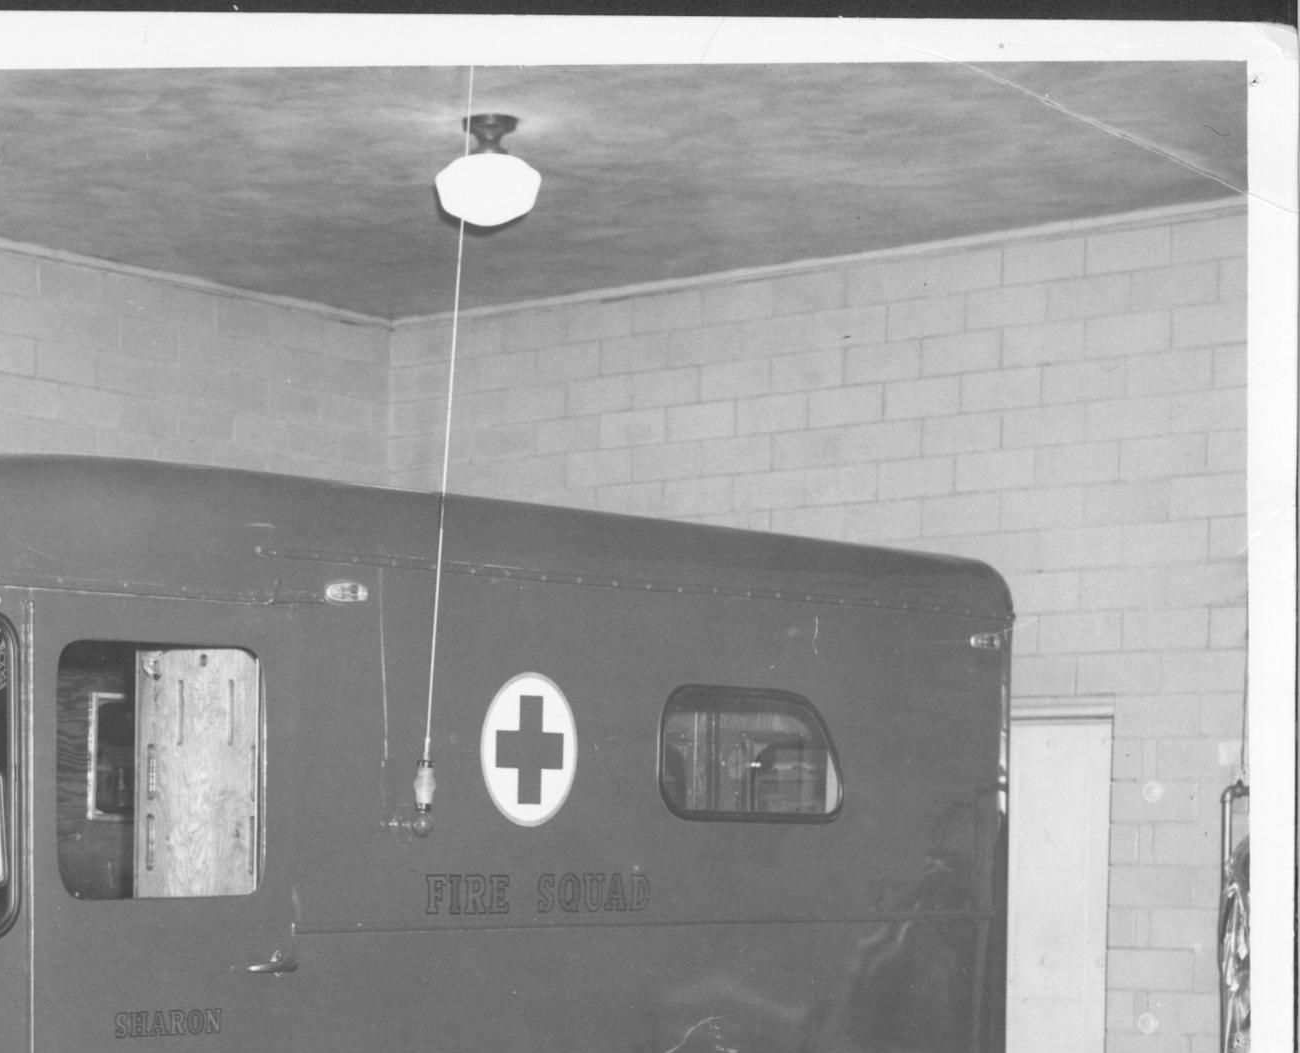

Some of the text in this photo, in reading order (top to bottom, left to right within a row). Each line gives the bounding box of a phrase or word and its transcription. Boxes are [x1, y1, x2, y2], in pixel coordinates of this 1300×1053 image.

[425, 872, 651, 915] FIRE SQUAD
[114, 1008, 222, 1039] SHARON
